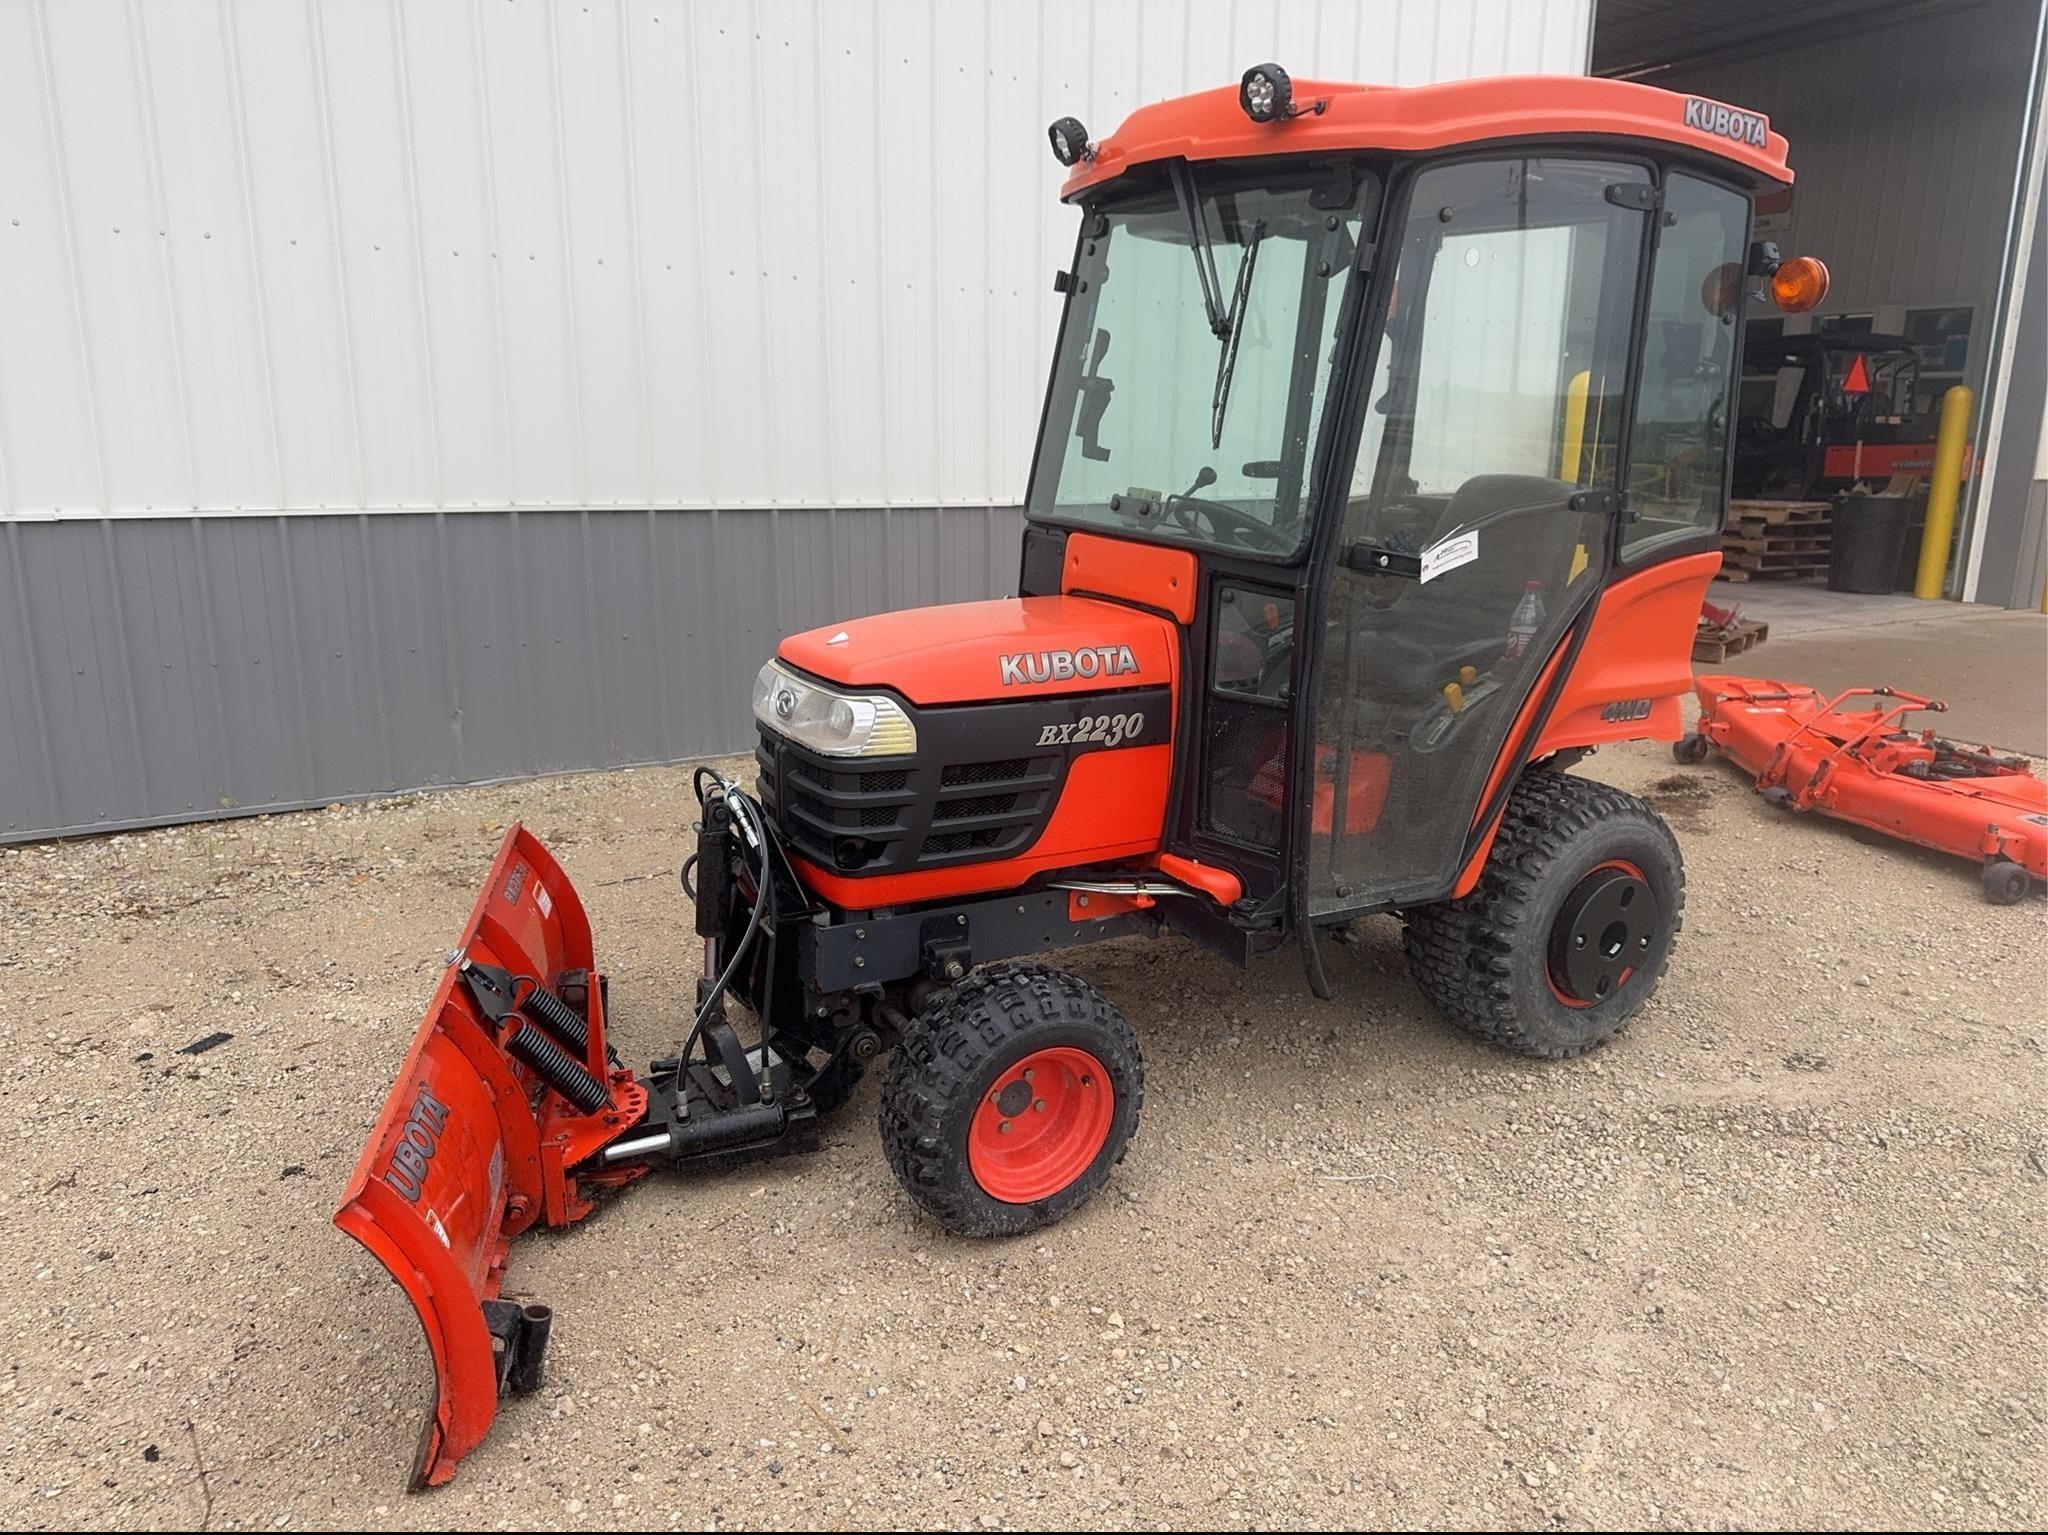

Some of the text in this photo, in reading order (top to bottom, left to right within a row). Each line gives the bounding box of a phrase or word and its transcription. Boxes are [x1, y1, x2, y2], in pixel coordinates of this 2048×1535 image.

[1683, 97, 1766, 148] KUBOTA
[999, 645, 1140, 686] KUBOTA
[1035, 712, 1145, 747] BX2230
[1600, 698, 1653, 723] 4WD
[384, 1090, 451, 1203] UBOTA
